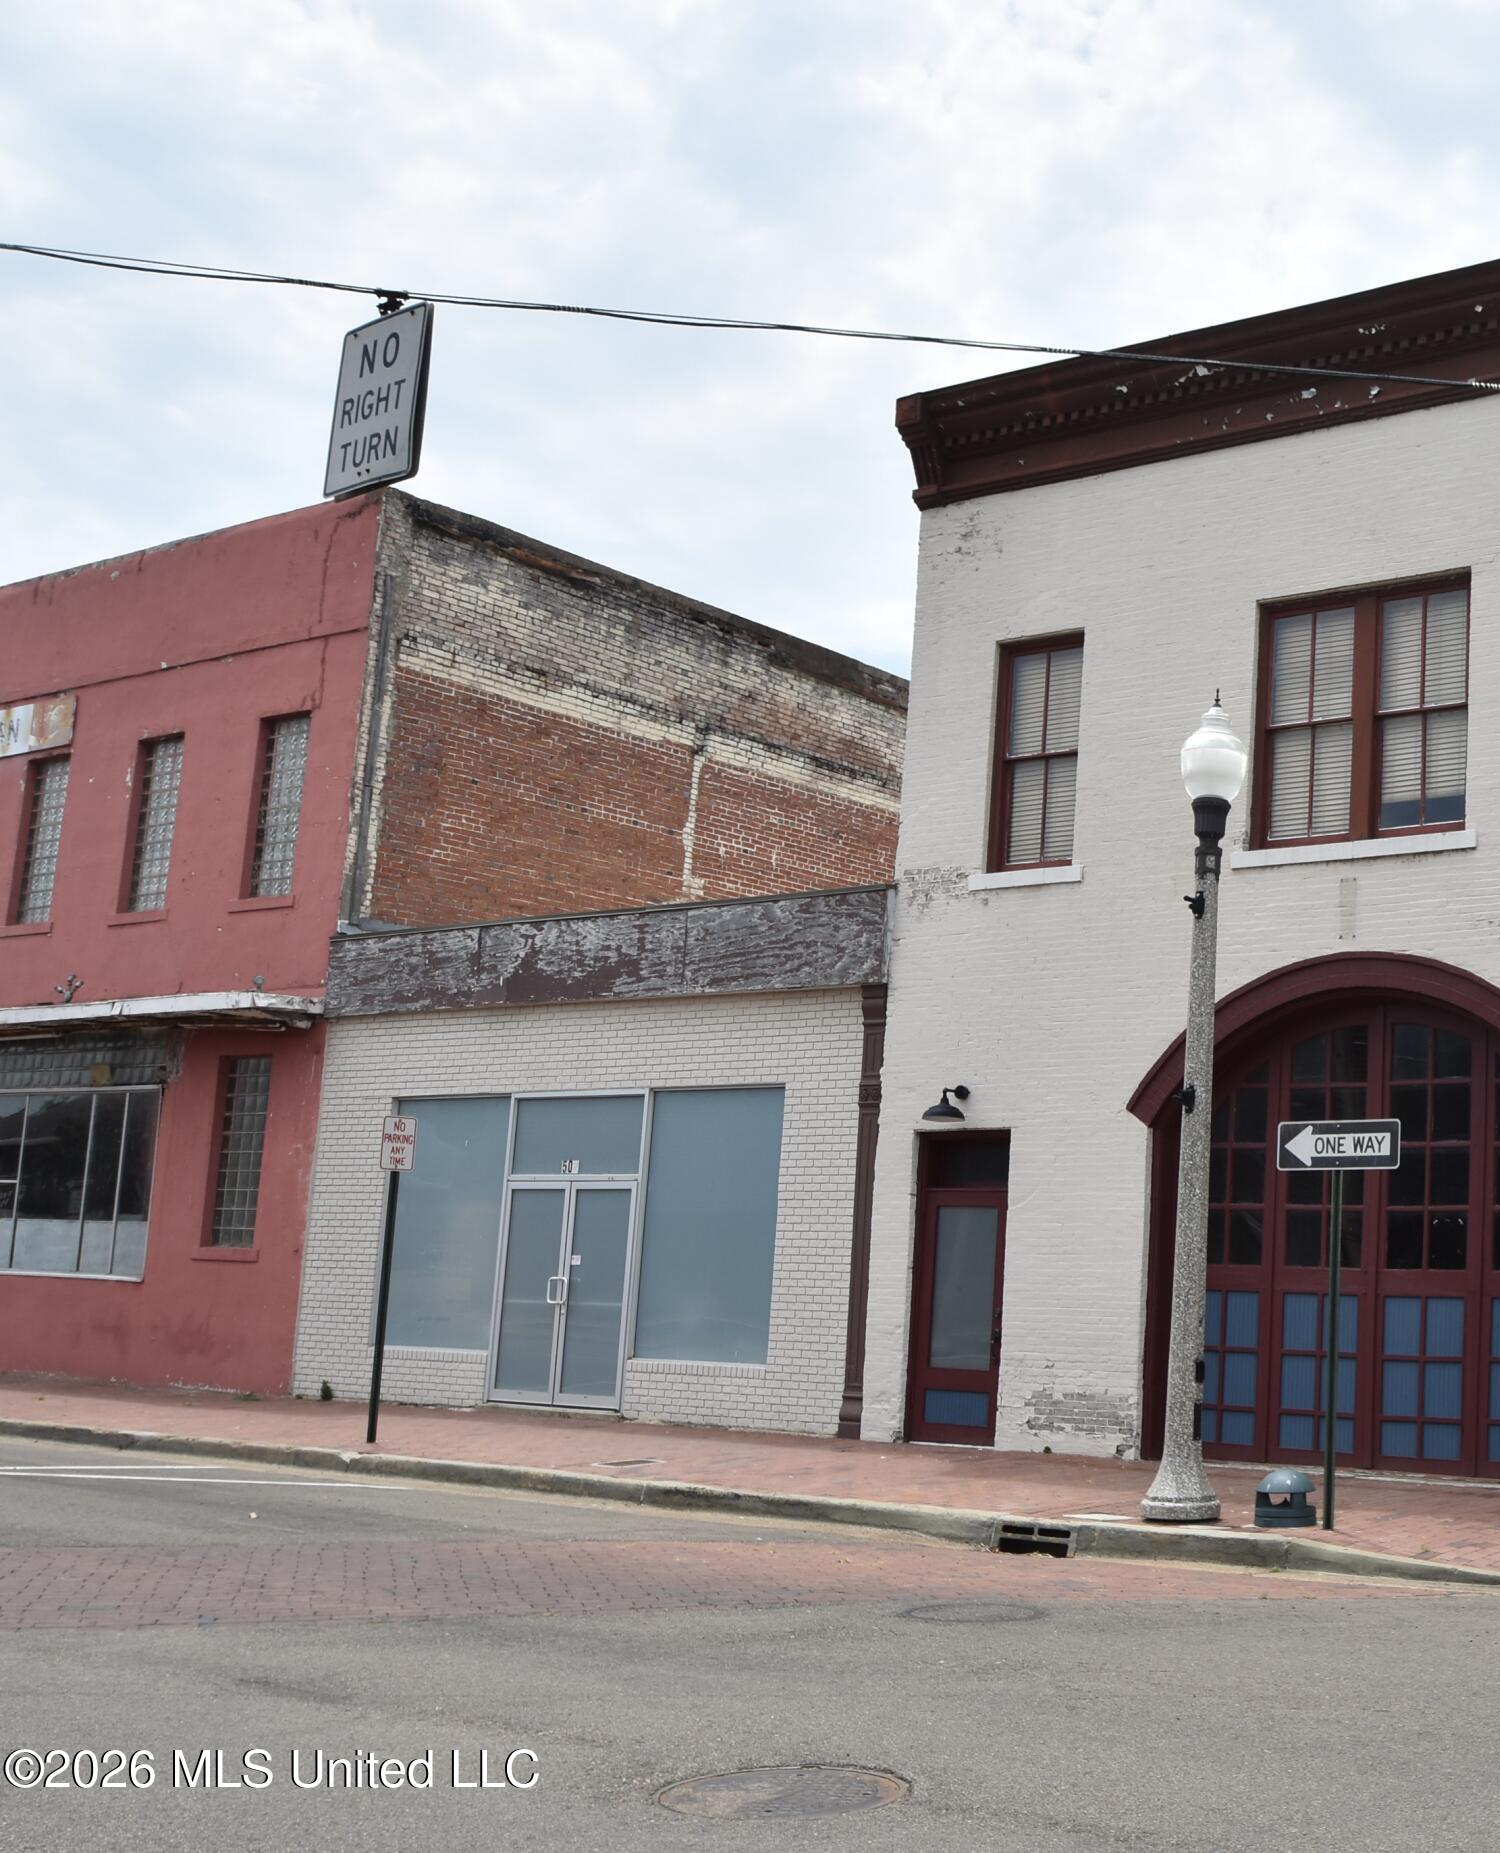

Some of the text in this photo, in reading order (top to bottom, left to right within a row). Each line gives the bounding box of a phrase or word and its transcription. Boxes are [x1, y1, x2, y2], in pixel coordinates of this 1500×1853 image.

[359, 331, 400, 379] NO
[340, 378, 406, 429] RIGHT
[340, 425, 399, 473] TURN
[394, 1121, 406, 1132] NO
[384, 1133, 413, 1145] PARKING
[1314, 1135, 1386, 1155] ONE WAY
[391, 1146, 405, 1155] ANY
[389, 1156, 406, 1166] TIME
